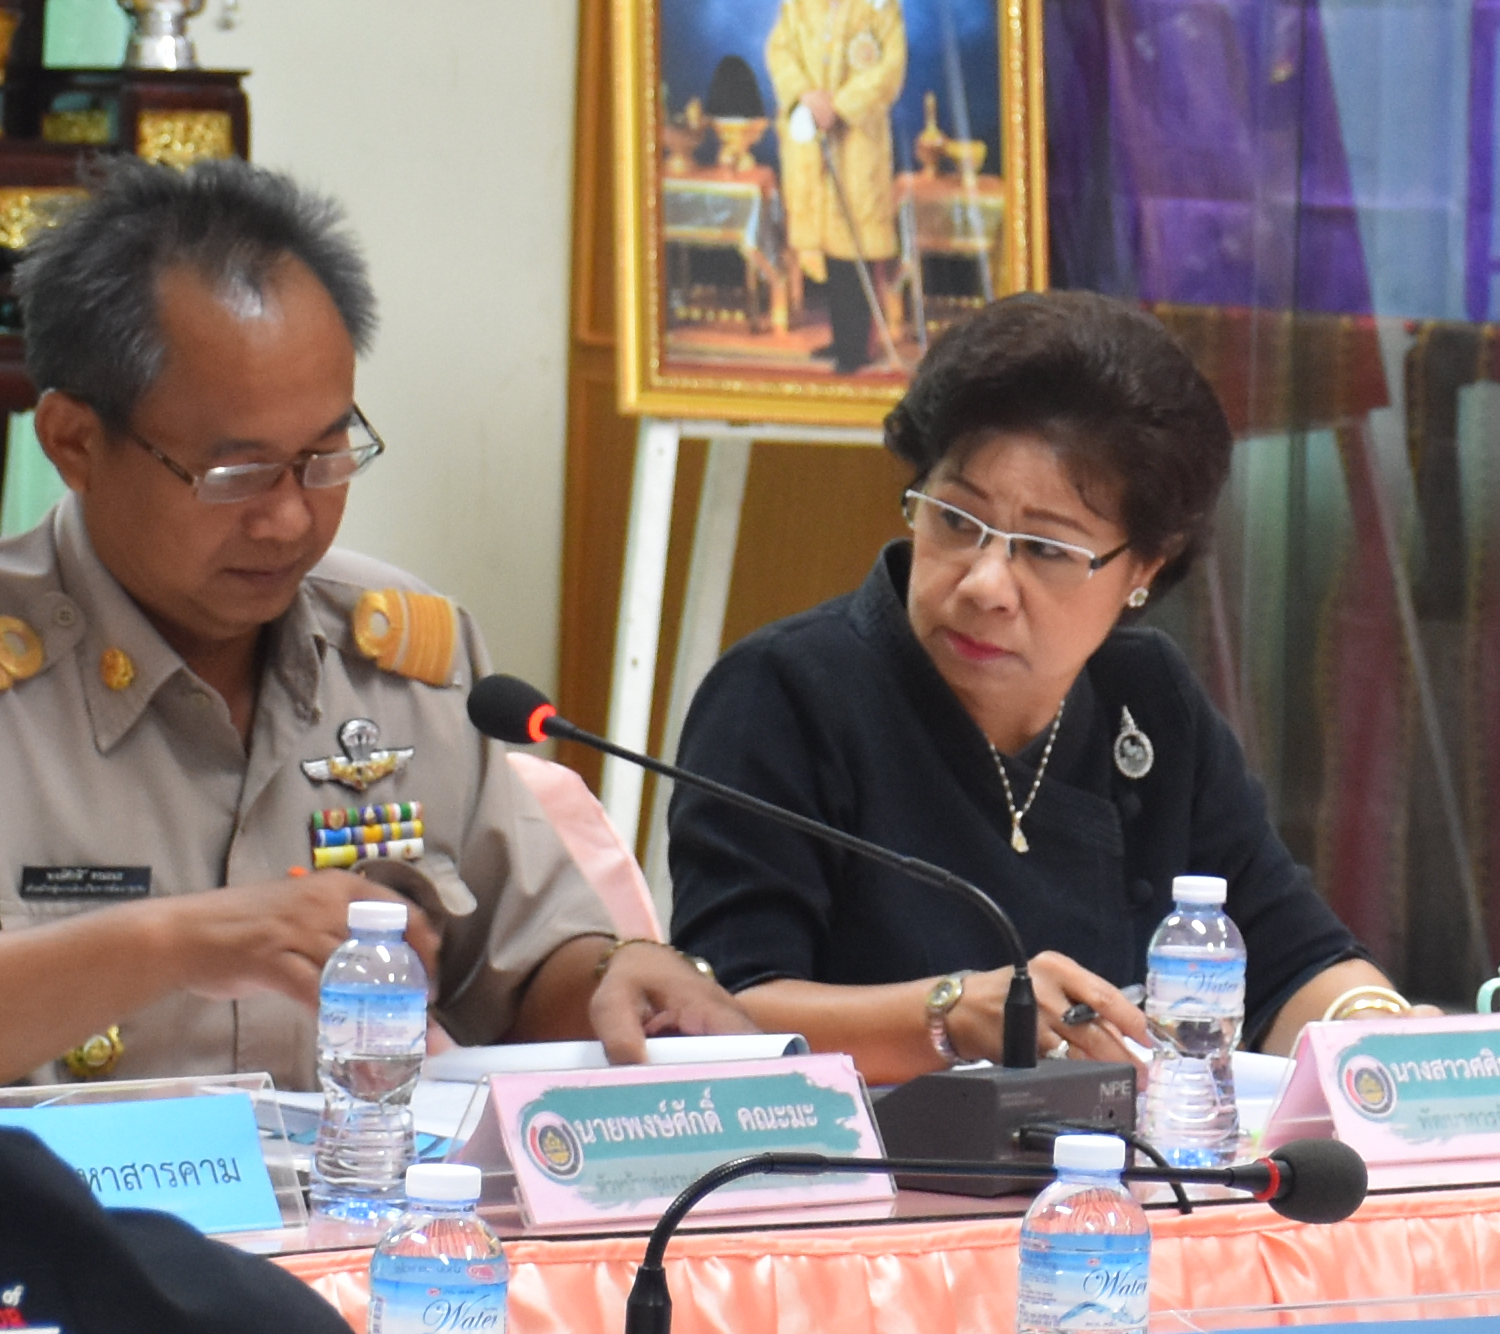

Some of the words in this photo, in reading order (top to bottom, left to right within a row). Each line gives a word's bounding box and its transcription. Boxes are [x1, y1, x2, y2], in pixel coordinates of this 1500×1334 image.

[1100, 1079, 1132, 1096] NPE
[573, 1086, 724, 1145] นายพงษ์ศักดิ์
[2, 1284, 25, 1306] of
[422, 1293, 498, 1333] Water
